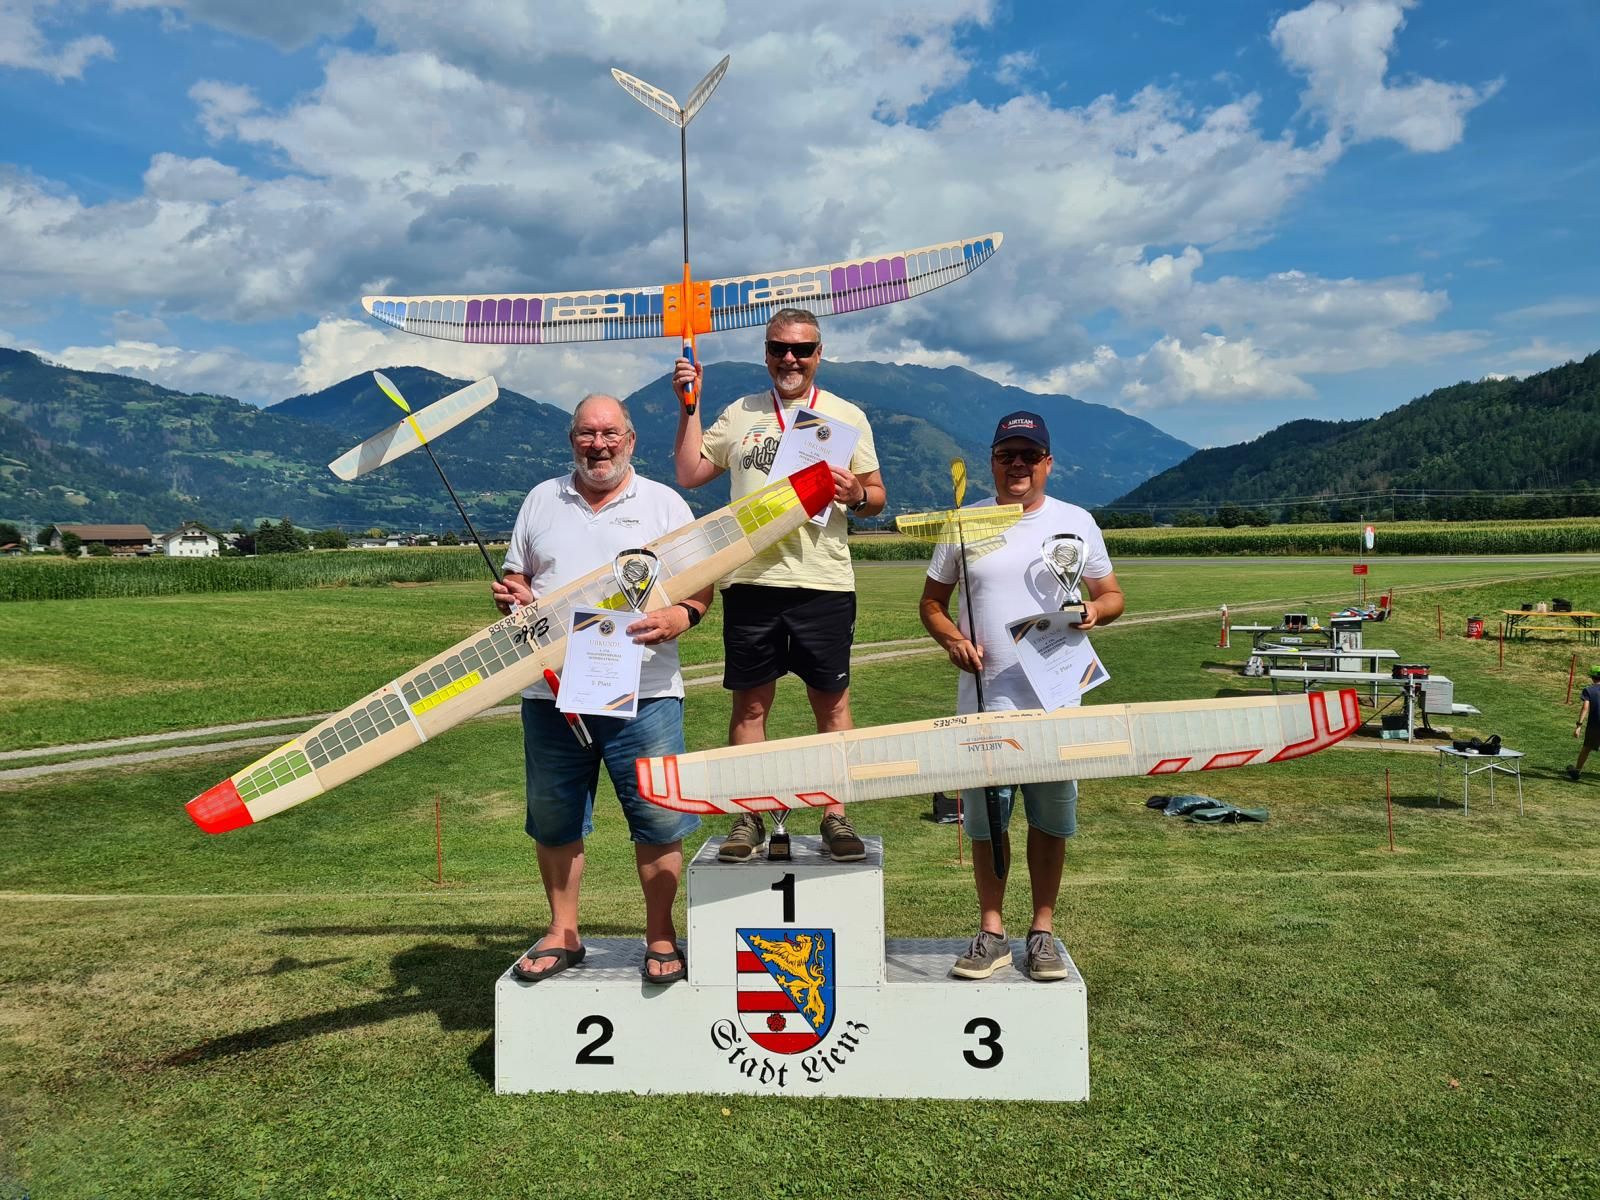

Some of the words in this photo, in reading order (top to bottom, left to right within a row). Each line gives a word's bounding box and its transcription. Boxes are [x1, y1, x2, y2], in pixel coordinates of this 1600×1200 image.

[489, 616, 516, 635] 48368
[520, 602, 539, 620] AUT
[933, 716, 968, 729] DiscRES
[967, 742, 1004, 752] AIRTEAM
[771, 872, 796, 923] 1
[576, 1015, 614, 1065] 2
[710, 1018, 789, 1088] Stadt
[801, 1020, 870, 1084] Lienz
[963, 1017, 1004, 1069] 3
